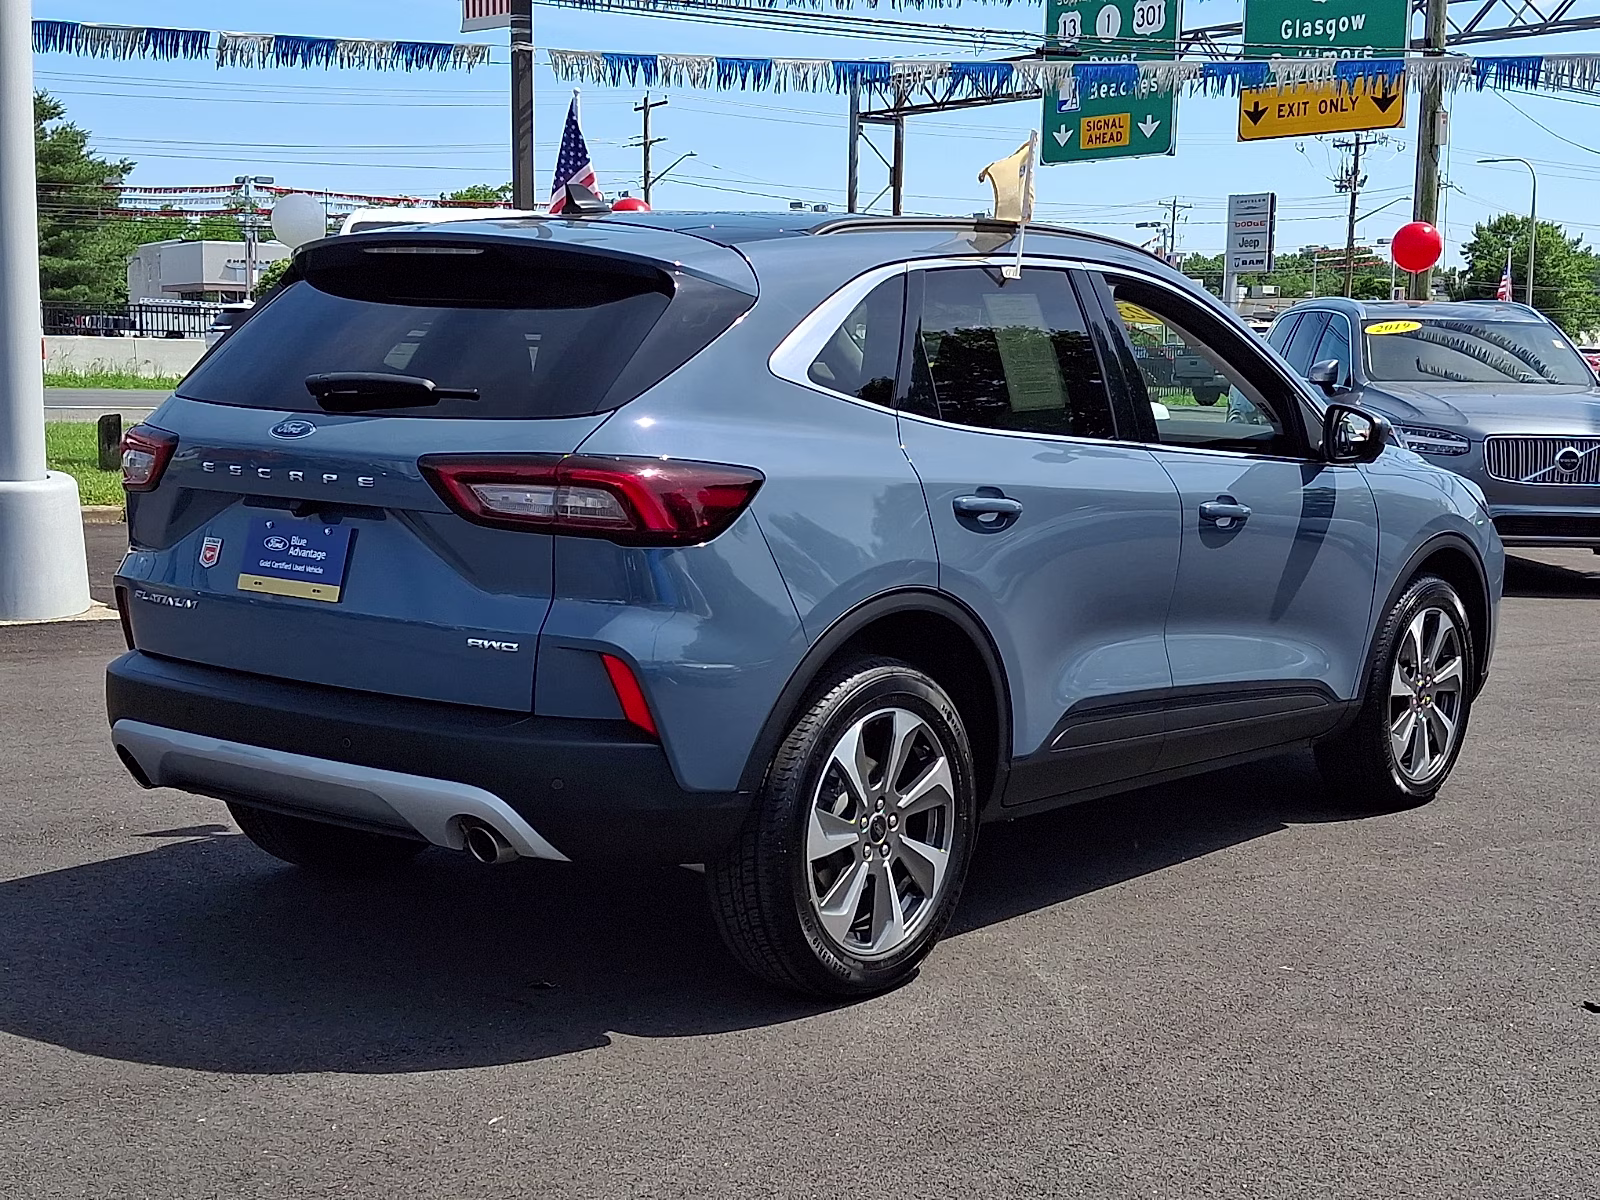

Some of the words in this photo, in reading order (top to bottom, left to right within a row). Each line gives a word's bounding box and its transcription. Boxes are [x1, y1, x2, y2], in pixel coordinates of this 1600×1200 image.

[1062, 18, 1077, 38] 13
[1106, 13, 1111, 34] 1
[1136, 4, 1162, 28] 301
[1281, 13, 1366, 42] Glasgow
[1277, 101, 1310, 119] EXIT
[1318, 96, 1359, 115] ONLY
[1086, 117, 1124, 132] SIGNAL
[1086, 131, 1123, 145] AHEAD
[1235, 220, 1265, 228] DODGE
[1238, 237, 1260, 250] Jeep
[1375, 322, 1411, 333] 2019
[202, 461, 374, 488] ESCAPE
[290, 536, 308, 546] Blue
[288, 546, 327, 560] Advantage
[259, 559, 271, 568] Gold
[271, 561, 292, 570] Certified
[292, 563, 305, 572] Used
[306, 565, 324, 574] Vehicle
[134, 589, 198, 609] PLATINUM
[467, 638, 519, 652] AWD
